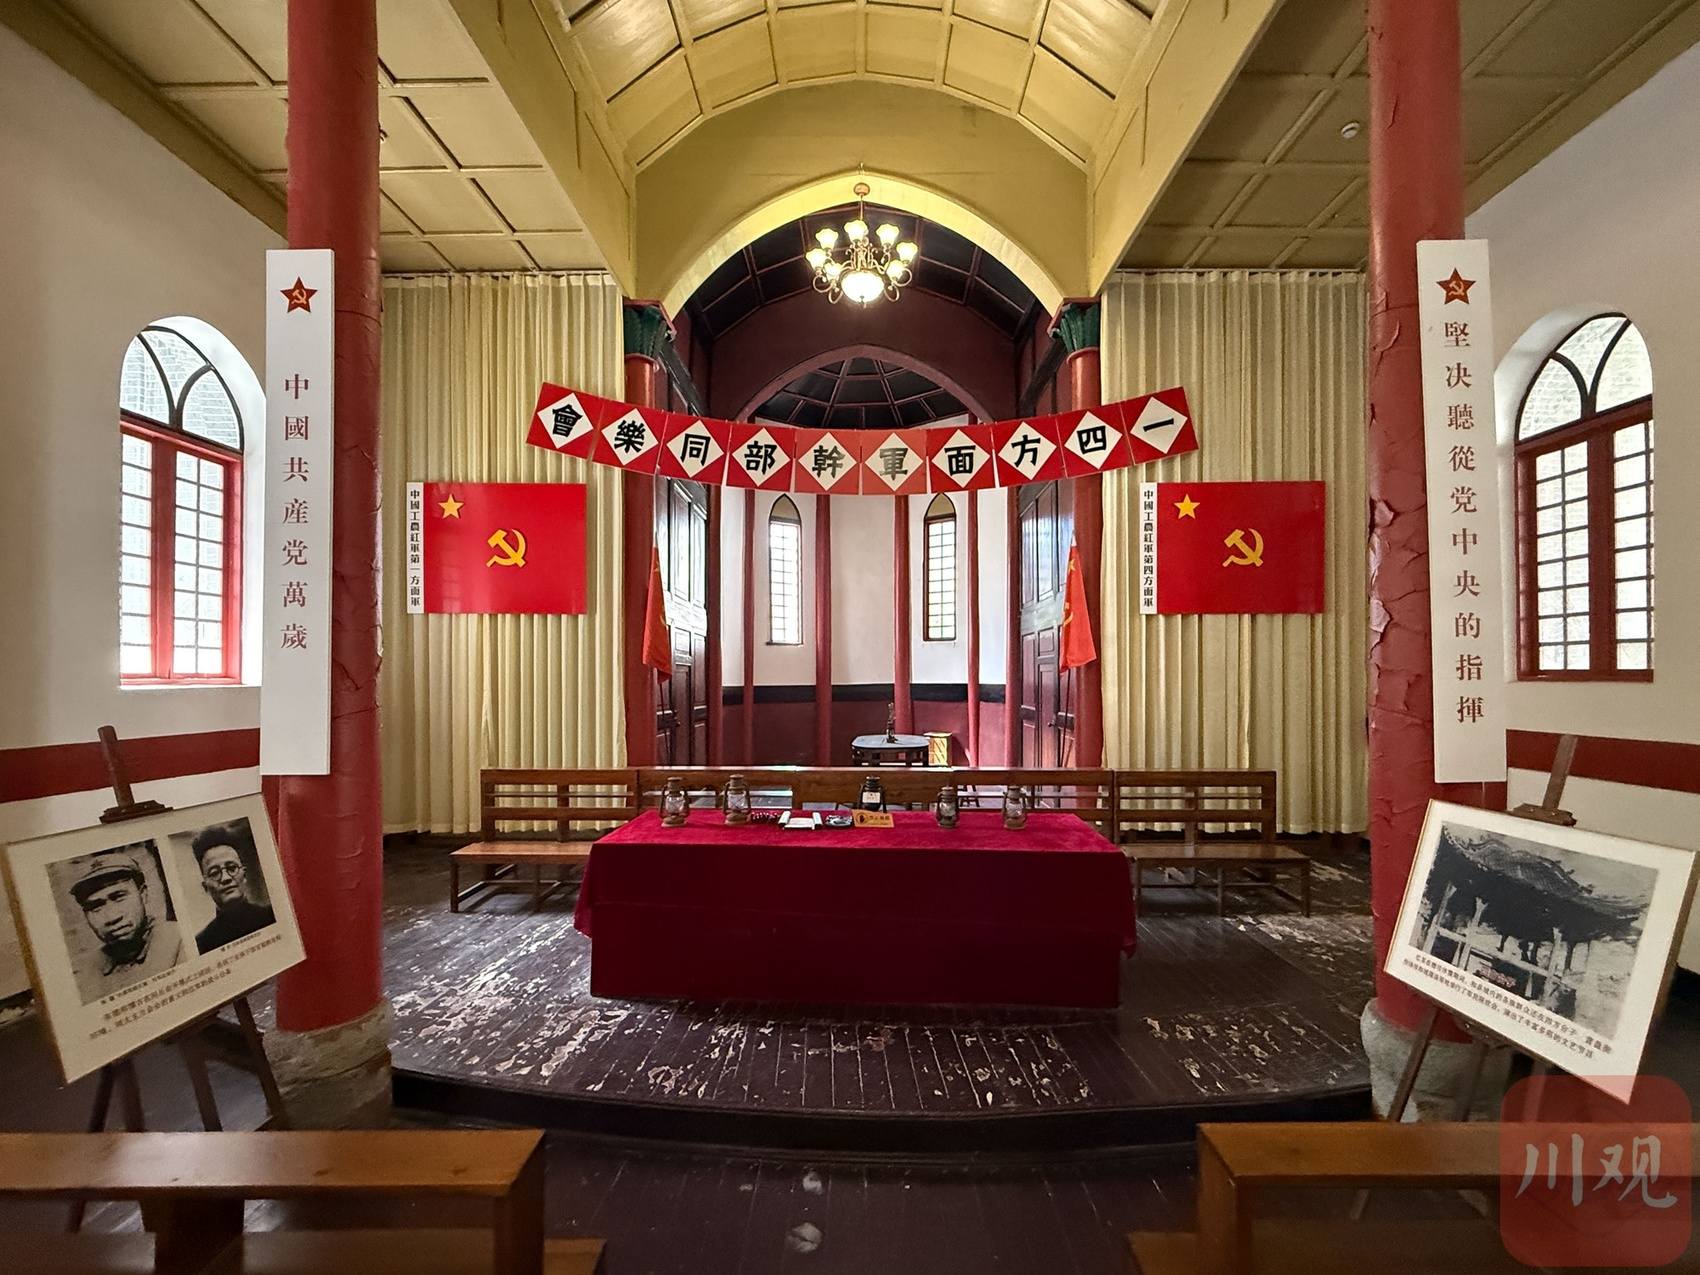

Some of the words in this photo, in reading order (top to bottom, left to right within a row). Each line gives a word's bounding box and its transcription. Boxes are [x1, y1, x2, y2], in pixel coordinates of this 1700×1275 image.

[409, 488, 421, 607] 中國工農紅軍第一方面軍
[1142, 489, 1154, 607] 中國工農紅軍第四方面軍
